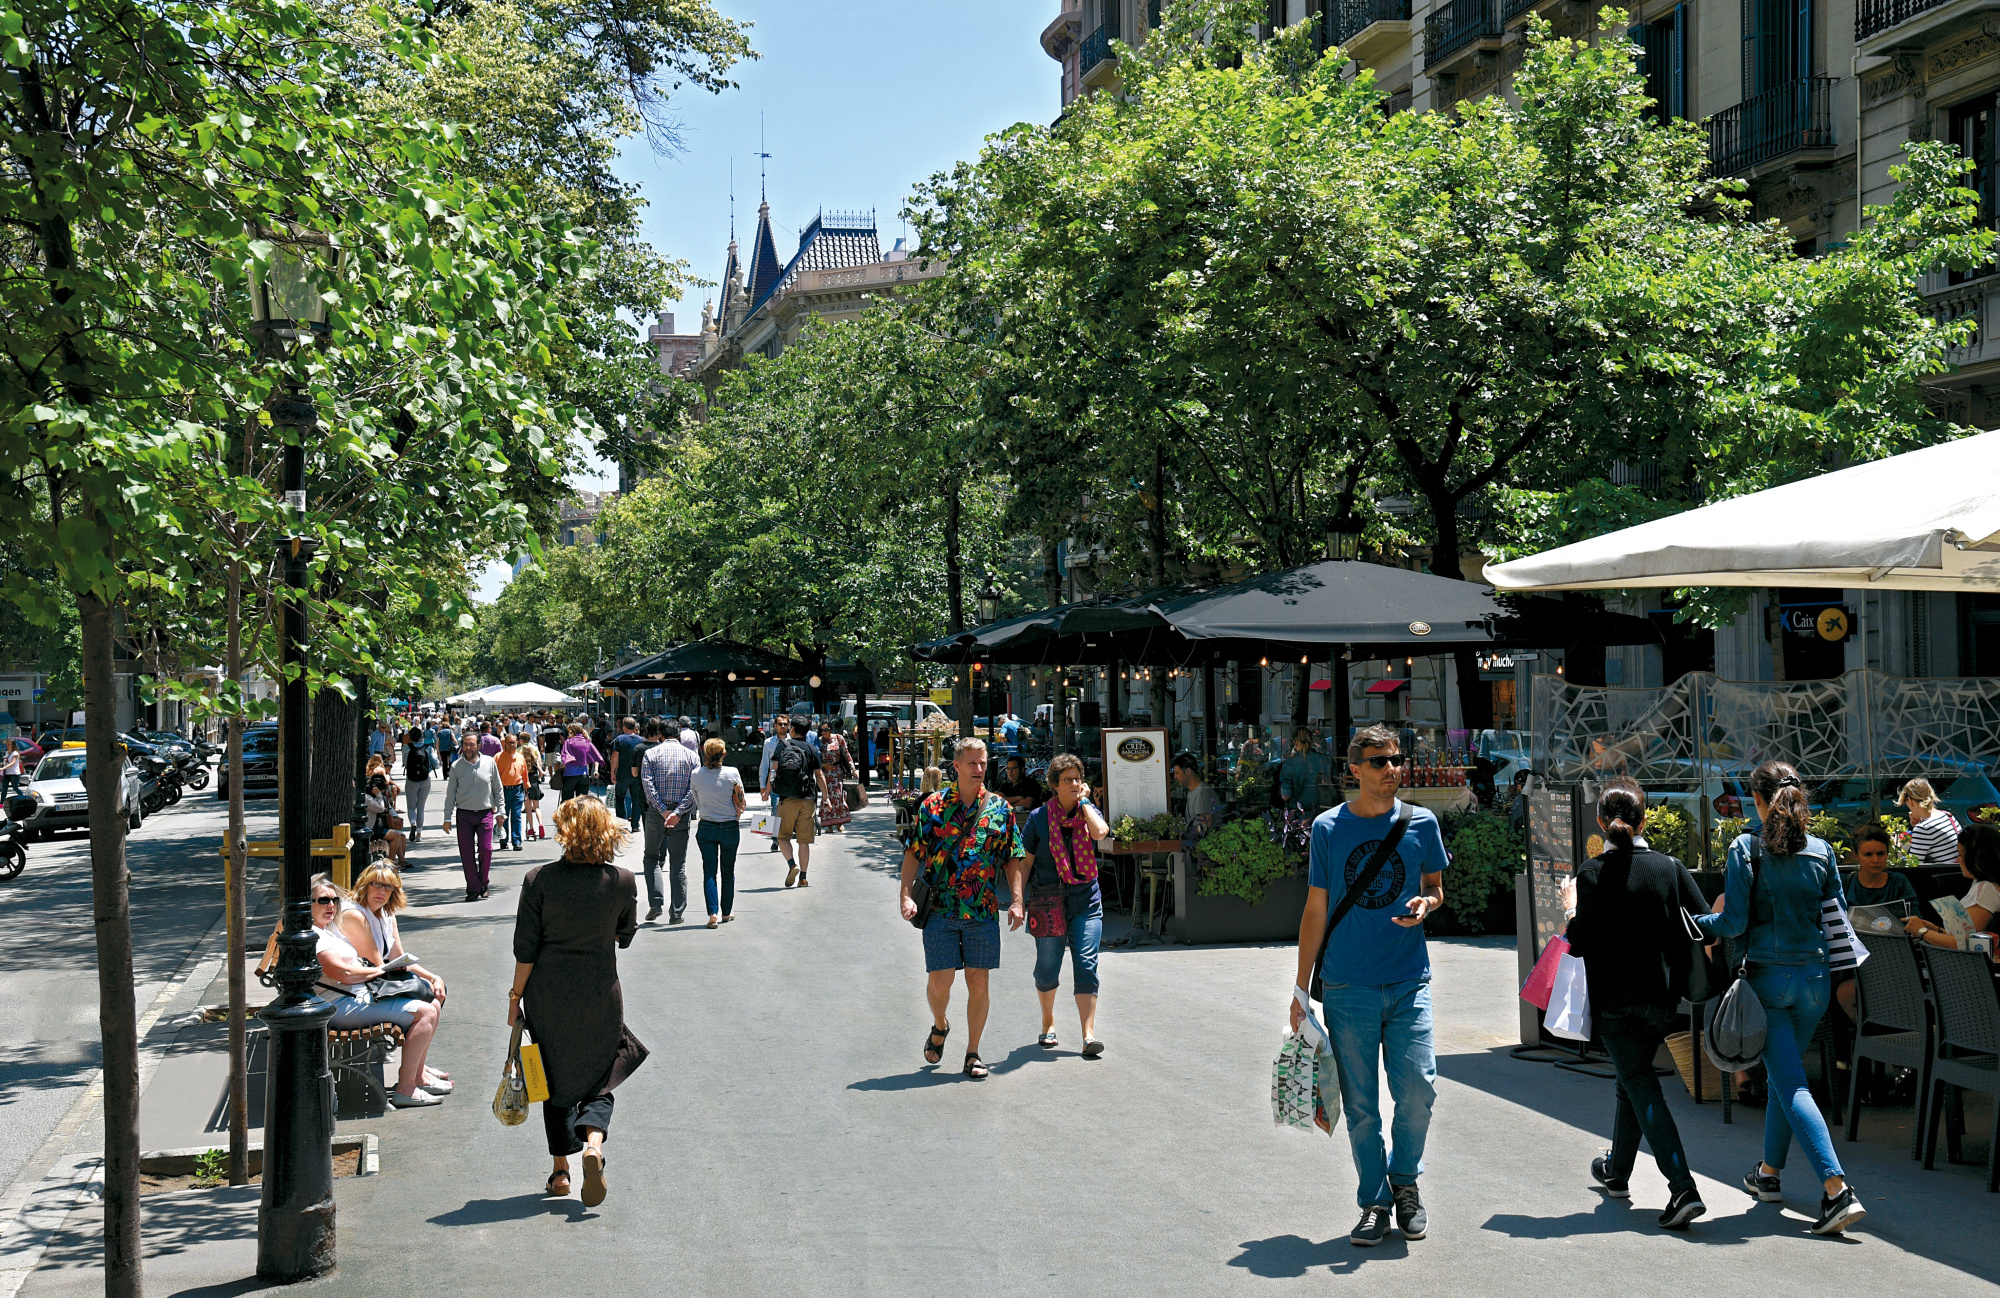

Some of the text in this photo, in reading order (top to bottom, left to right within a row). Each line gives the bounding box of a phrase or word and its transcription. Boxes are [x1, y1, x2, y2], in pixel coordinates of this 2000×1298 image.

[1478, 657, 1491, 670] my
[0, 688, 21, 698] gen
[1349, 849, 1364, 864] SIDE
